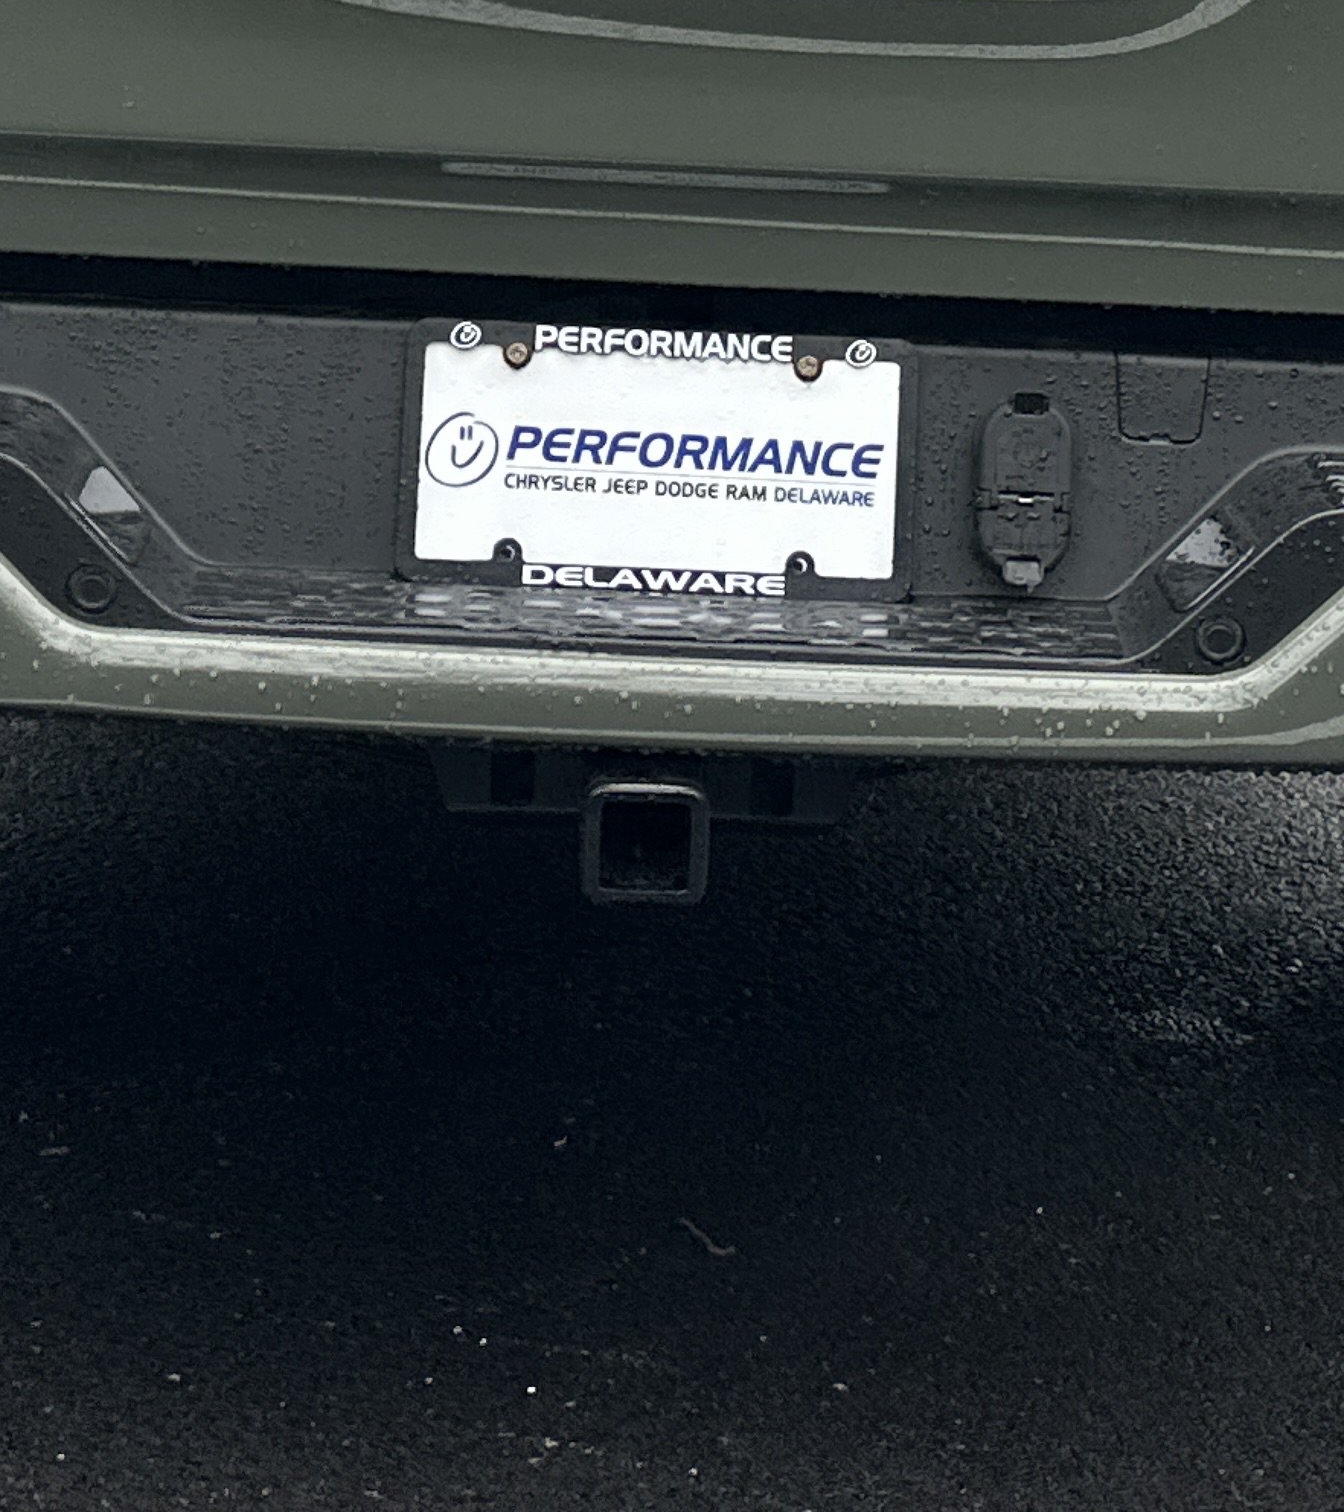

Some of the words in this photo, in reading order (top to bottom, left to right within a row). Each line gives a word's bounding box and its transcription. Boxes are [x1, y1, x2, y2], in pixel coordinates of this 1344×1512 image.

[535, 324, 793, 362] PERFORMANCE
[507, 425, 884, 478] PERFORMANCE
[504, 473, 596, 493] CHRYSLER
[602, 478, 648, 495] JEEP
[655, 480, 718, 499] DODGE
[727, 484, 767, 502] RAM
[774, 486, 875, 507] DELAWARE
[522, 564, 785, 596] DELAWARE
